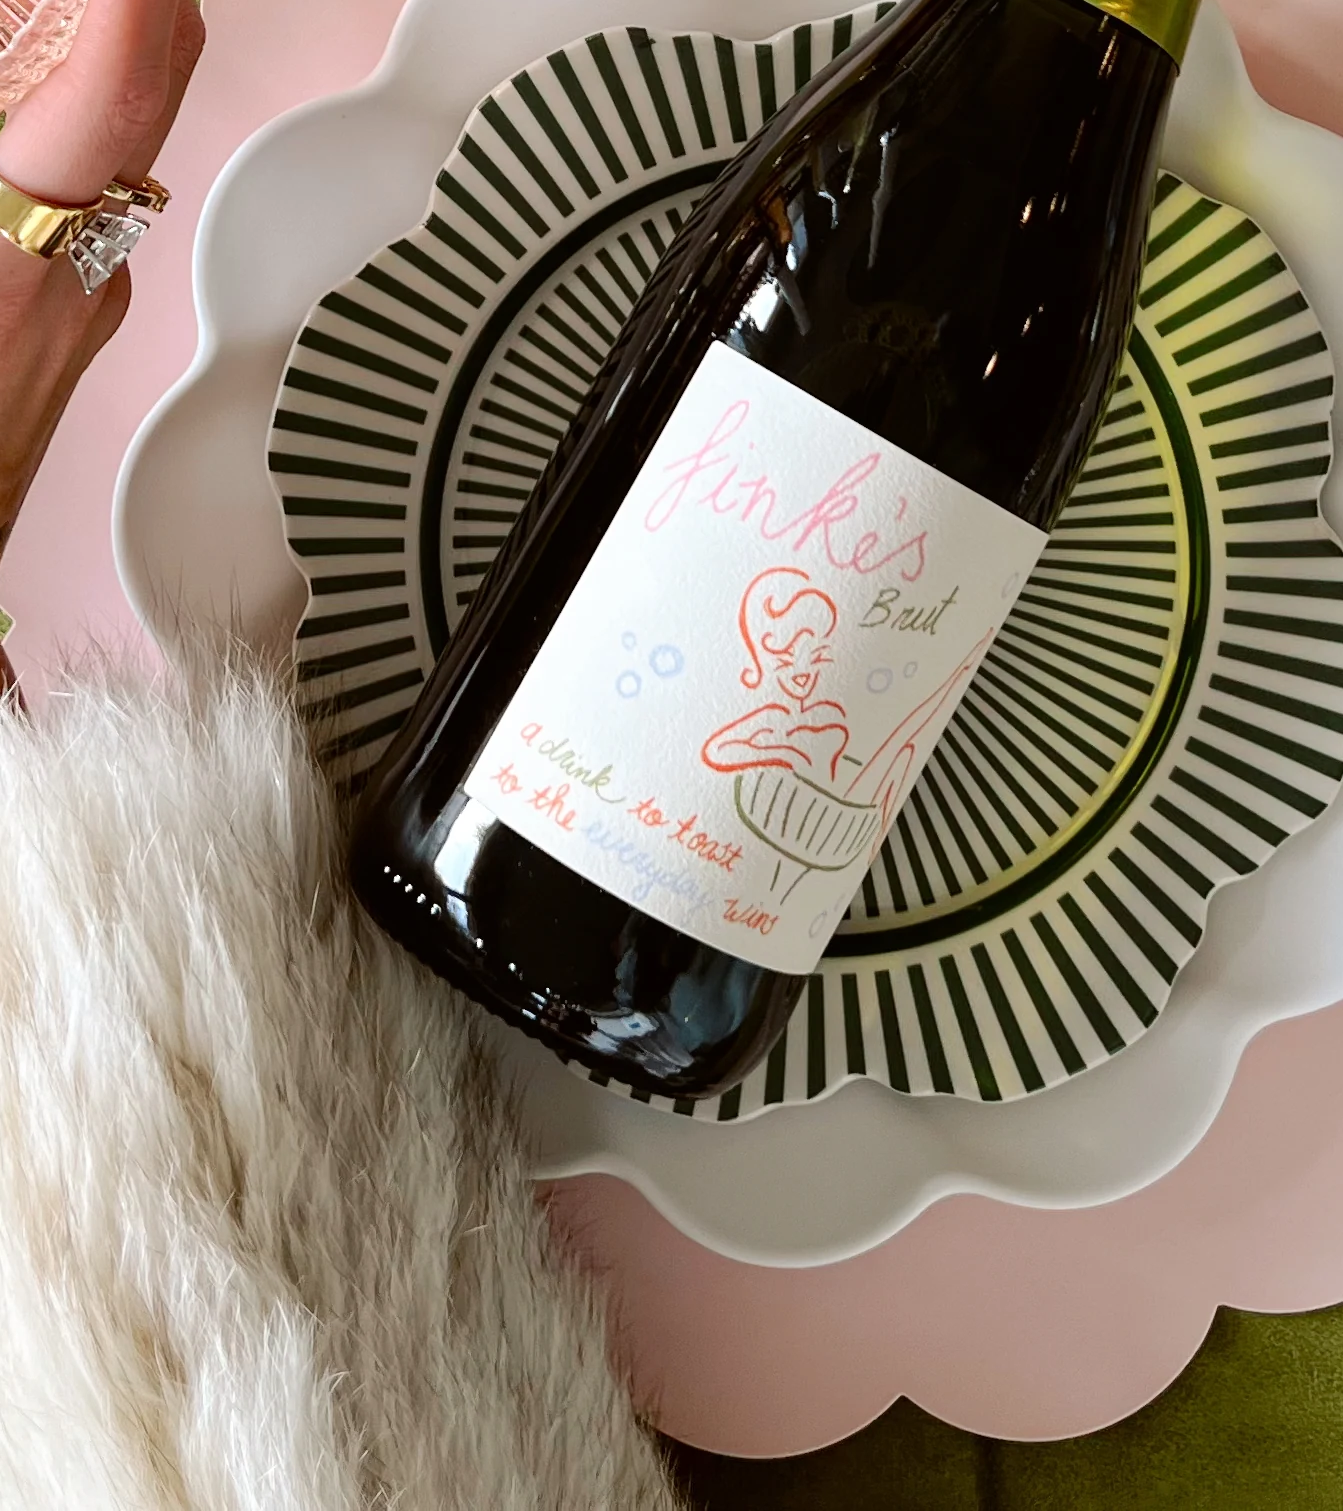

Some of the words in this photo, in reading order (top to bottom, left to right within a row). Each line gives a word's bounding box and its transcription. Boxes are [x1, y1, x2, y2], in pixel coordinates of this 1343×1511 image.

[644, 399, 928, 582] finke's
[858, 584, 960, 636] Brut
[489, 762, 524, 795] to
[524, 782, 578, 833] the
[519, 721, 544, 748] a
[538, 737, 627, 804] drink
[626, 796, 671, 828] to
[666, 813, 744, 873] toast
